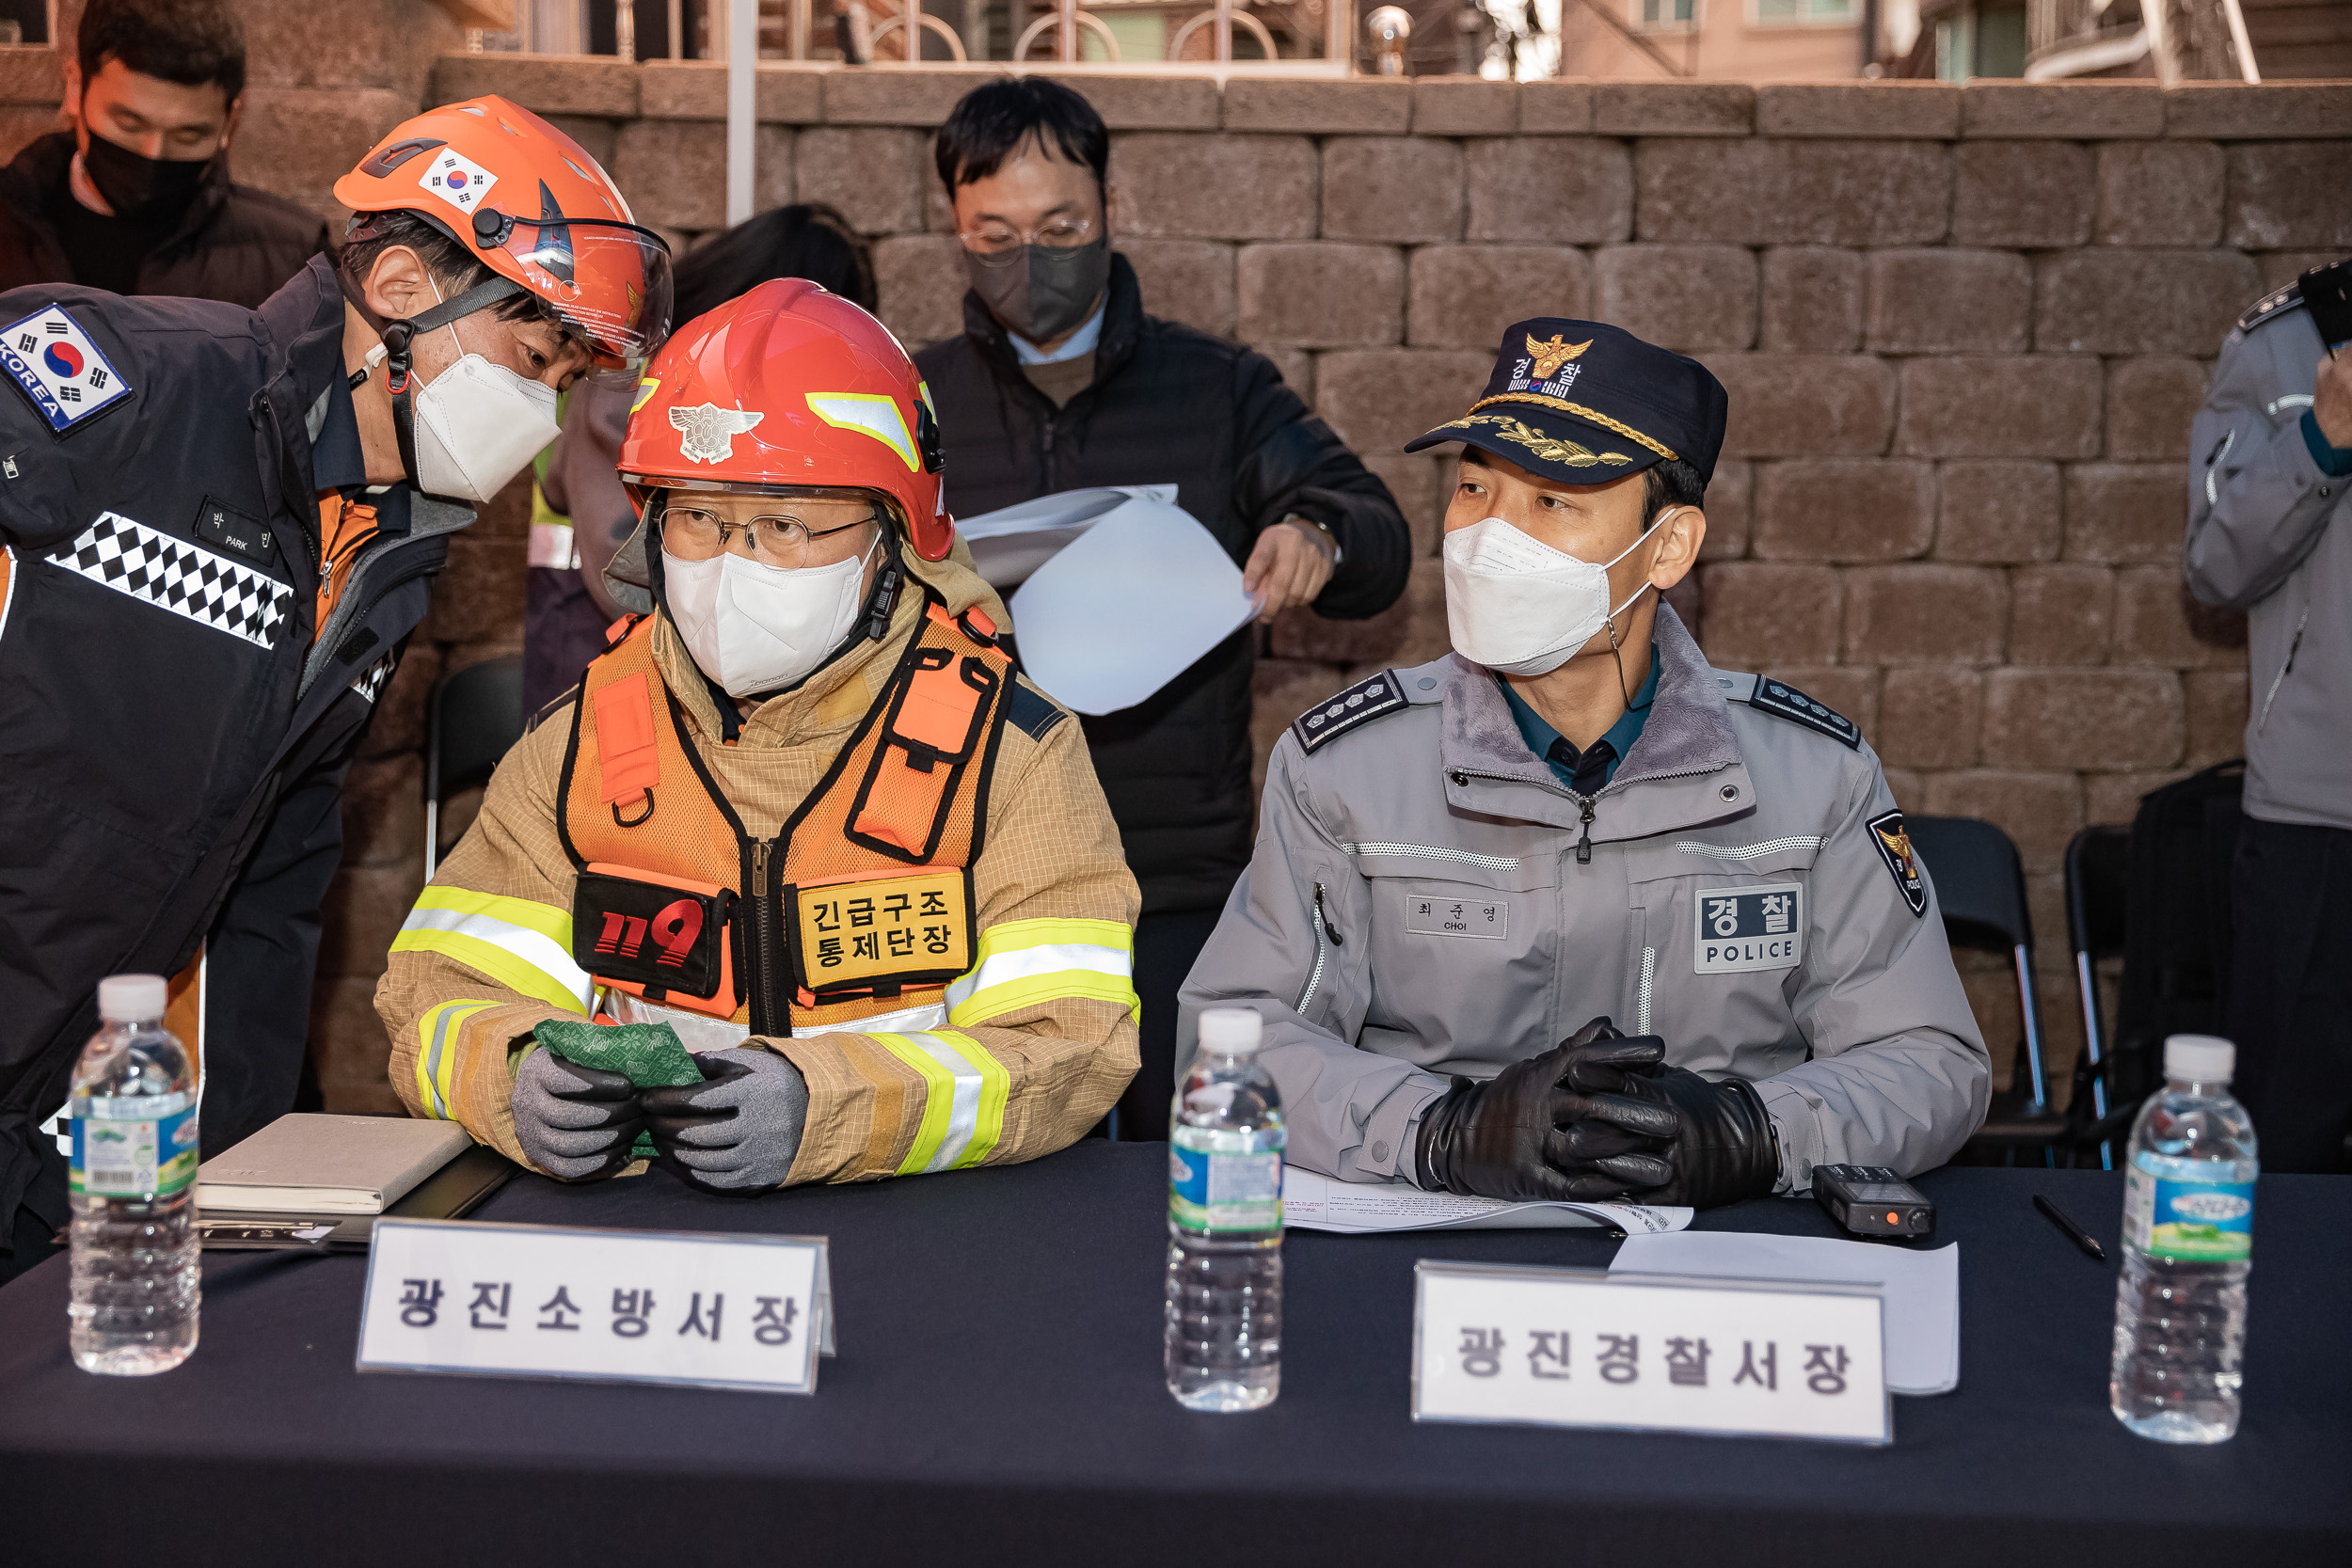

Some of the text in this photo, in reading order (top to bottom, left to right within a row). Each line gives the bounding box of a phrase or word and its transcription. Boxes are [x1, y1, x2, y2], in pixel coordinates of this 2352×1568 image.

[0, 342, 59, 418] KOREA
[226, 535, 248, 551] PARK
[813, 889, 950, 933] 긴급구조
[1443, 922, 1467, 931] CHOI
[1708, 895, 1792, 937] 경찰
[594, 898, 704, 968] 119
[816, 924, 952, 969] 통제단장
[1707, 941, 1792, 963] POLICE
